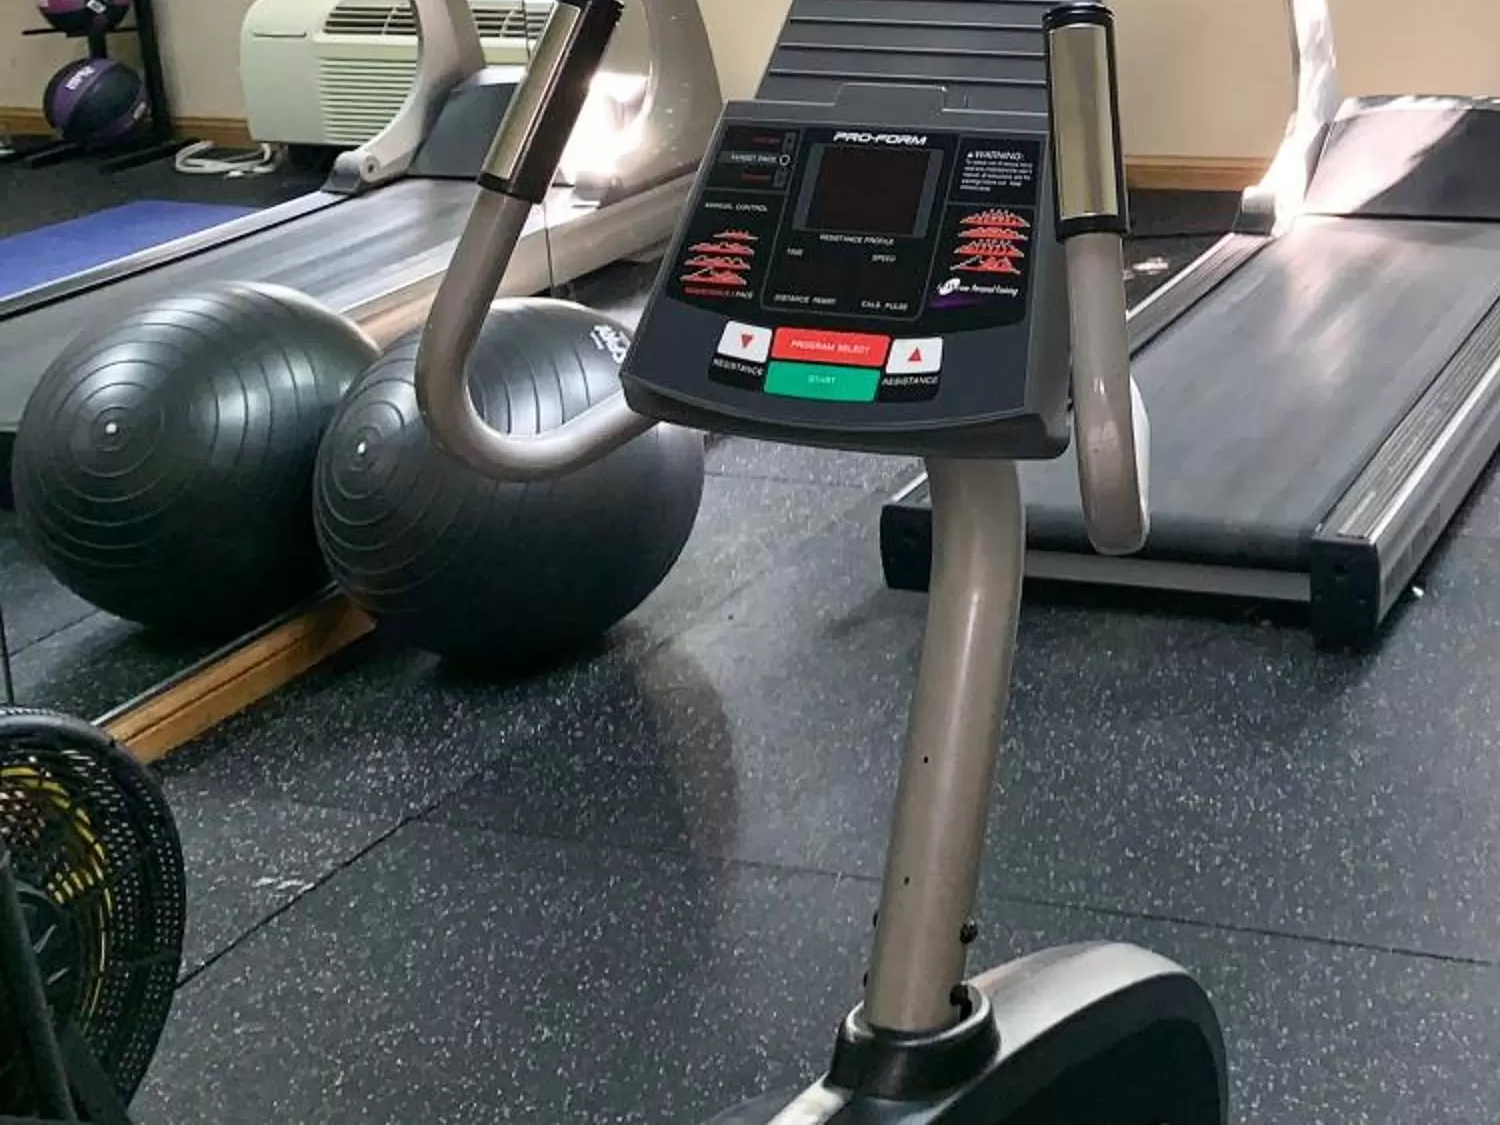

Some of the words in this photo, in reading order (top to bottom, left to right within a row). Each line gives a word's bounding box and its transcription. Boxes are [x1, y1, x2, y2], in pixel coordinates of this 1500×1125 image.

[833, 131, 928, 146] PRO-FORM
[789, 338, 836, 351] PROGRAM
[837, 341, 871, 355] SELECT
[713, 358, 765, 377] RESISTANCE
[807, 375, 837, 385] START
[882, 375, 939, 387] RESISTANCE
